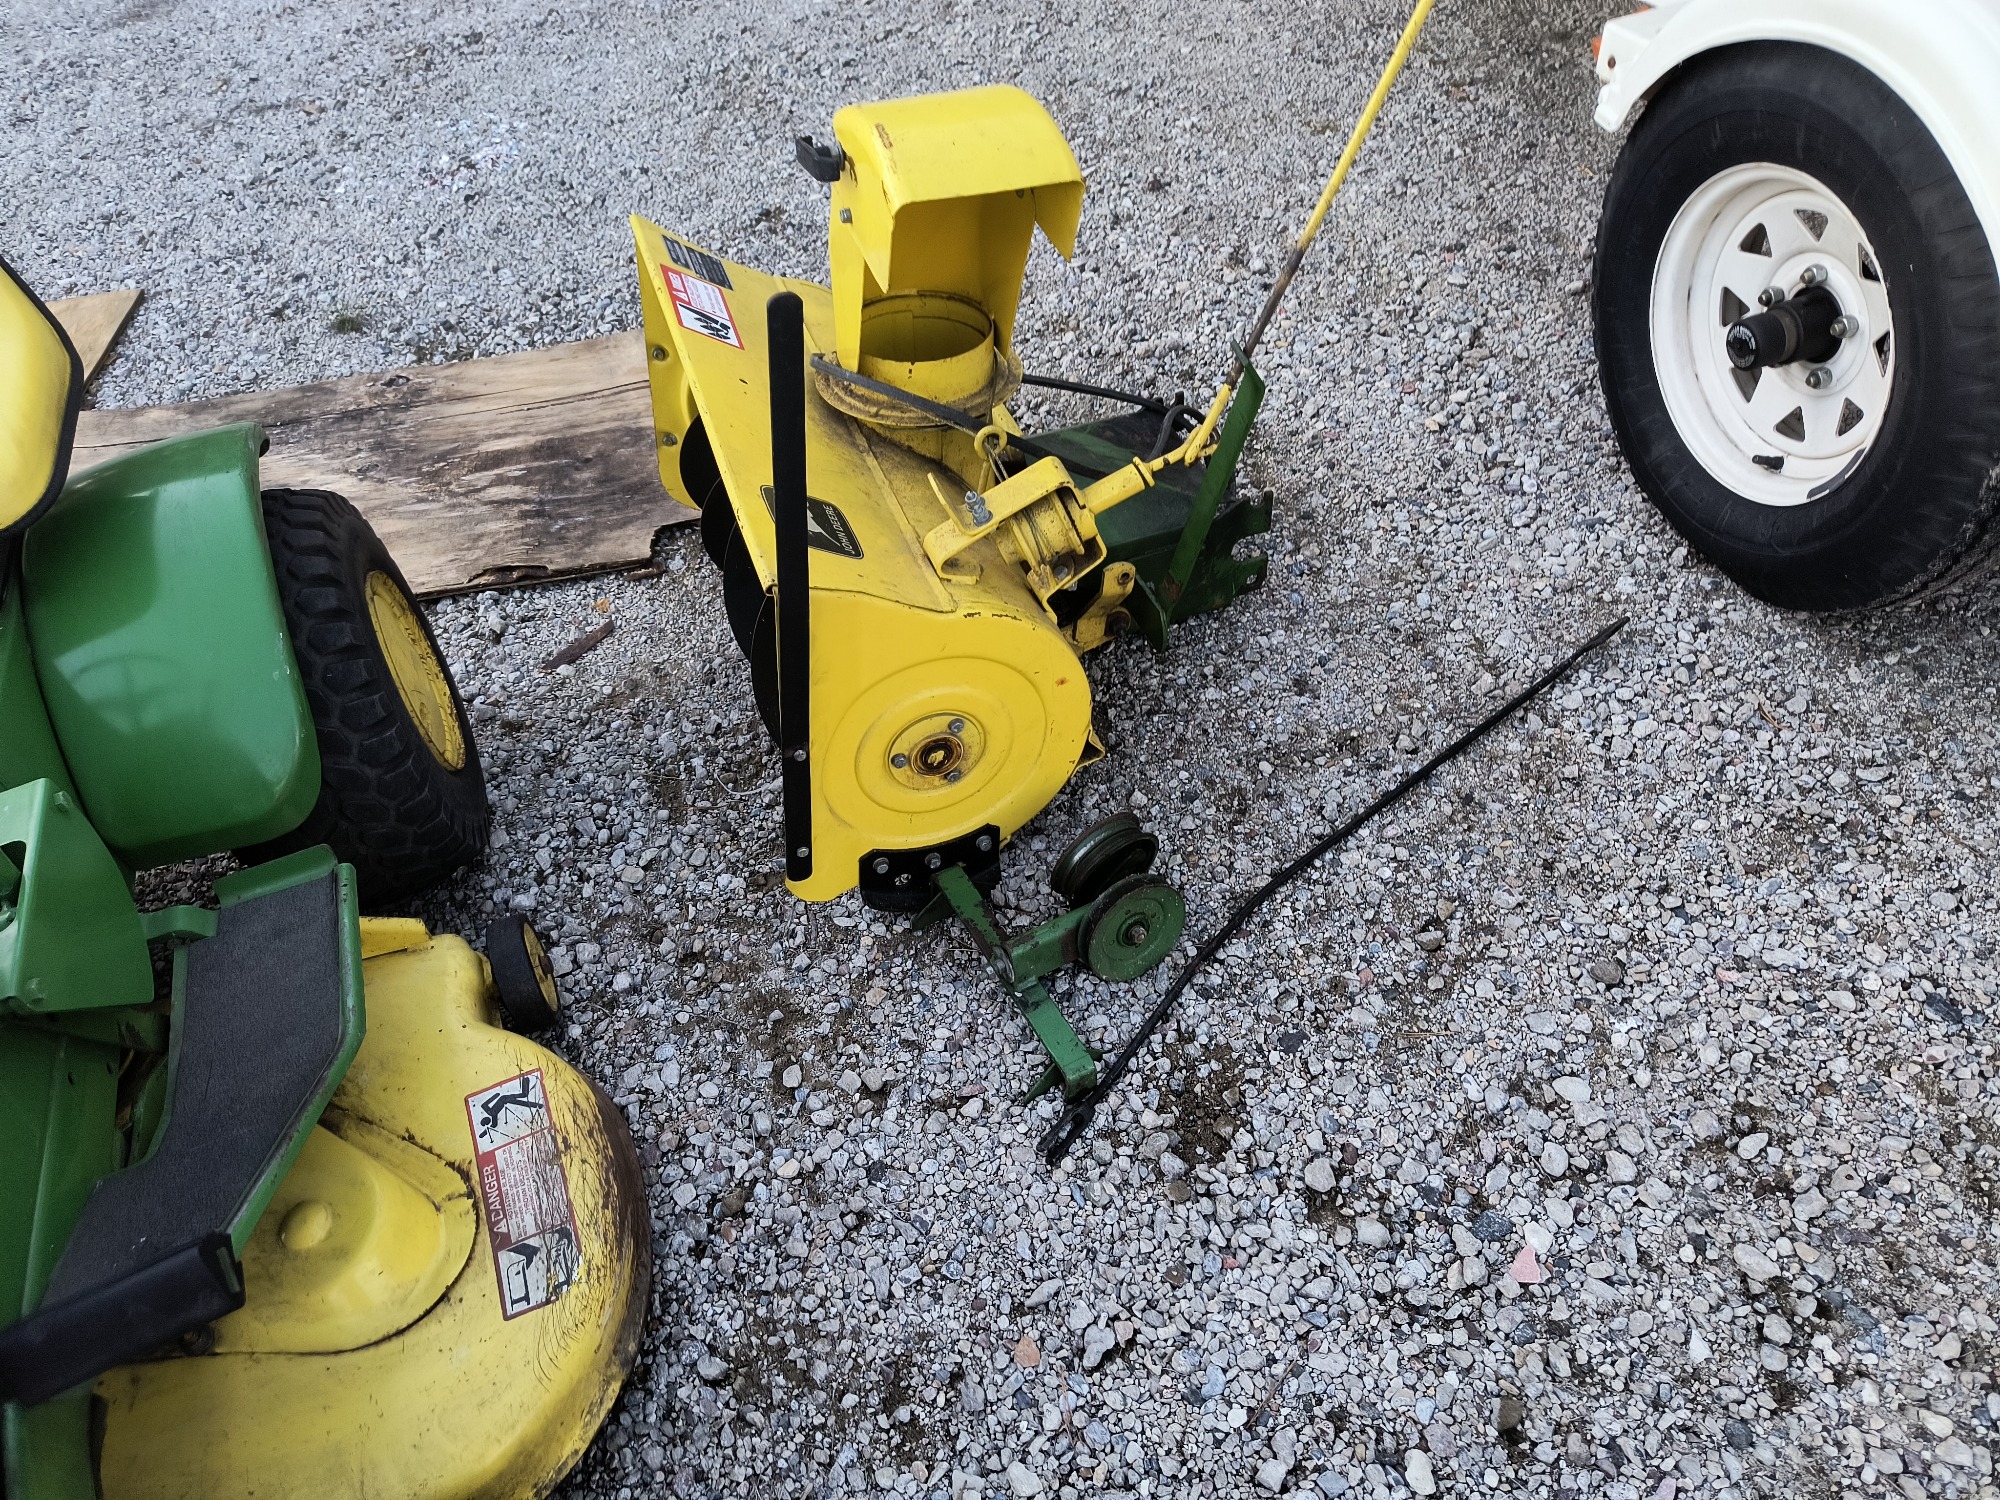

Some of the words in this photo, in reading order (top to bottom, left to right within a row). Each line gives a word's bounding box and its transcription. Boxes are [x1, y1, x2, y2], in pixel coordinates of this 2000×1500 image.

[822, 504, 843, 531] DEERE
[836, 530, 855, 554] JOHN
[499, 1167, 507, 1187] BLADE
[515, 1159, 526, 1187] OBJECTS
[483, 1164, 504, 1222] DANGER
[503, 1188, 514, 1221] ROTATING
[520, 1186, 531, 1215] THROWN
